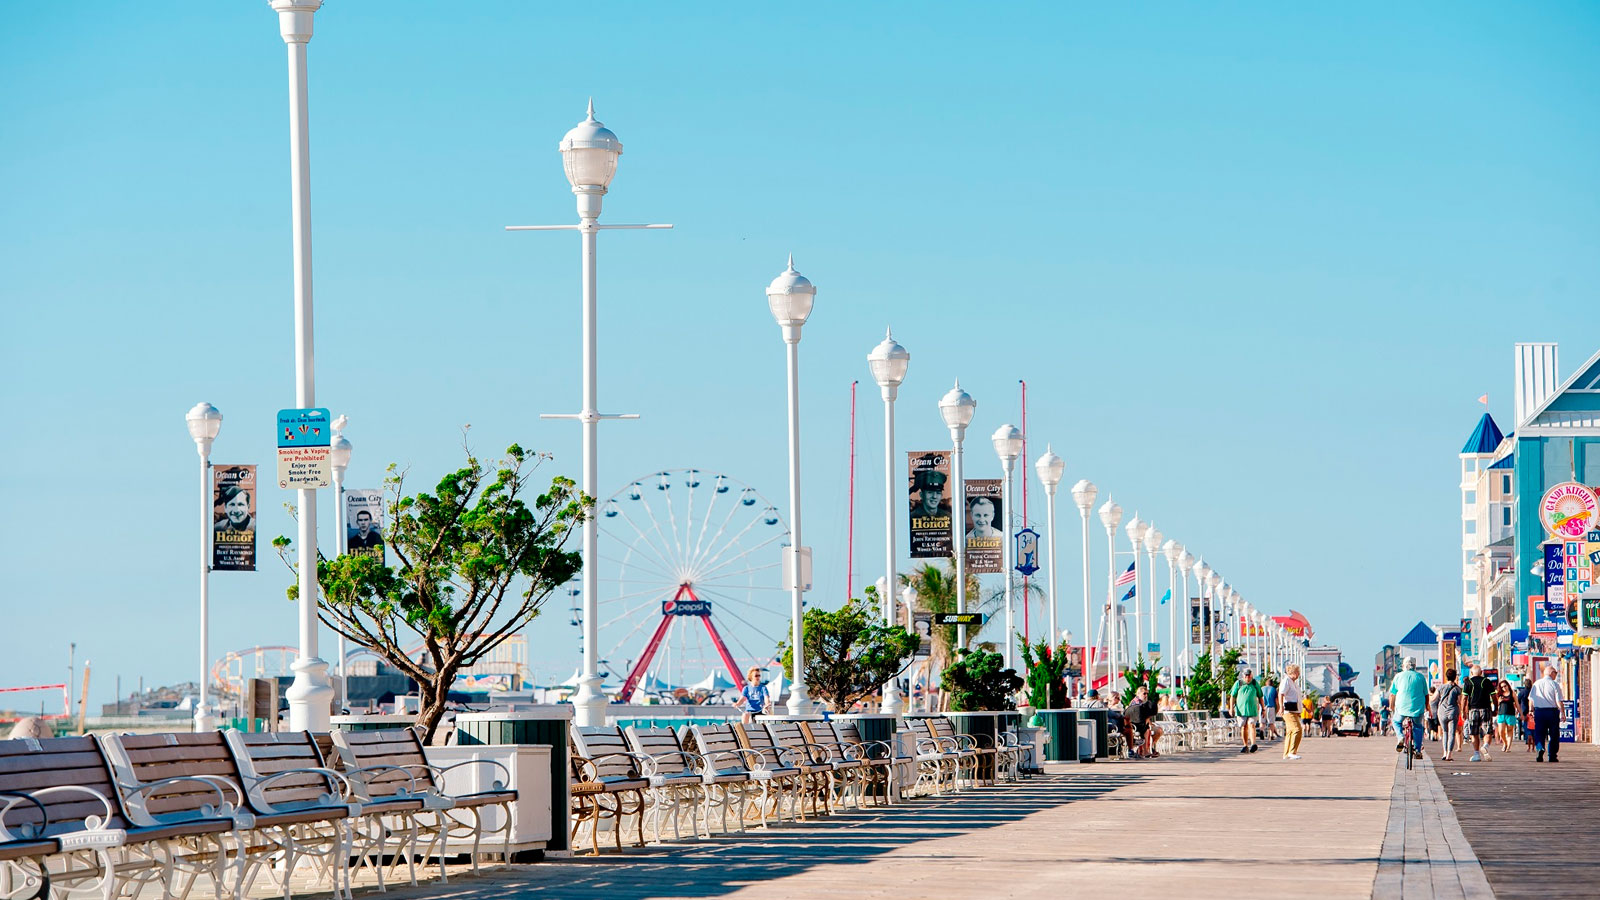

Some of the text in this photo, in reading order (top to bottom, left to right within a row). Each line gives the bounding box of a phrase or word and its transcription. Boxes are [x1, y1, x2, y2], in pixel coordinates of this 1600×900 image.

[909, 456, 949, 466] Ocean City
[215, 470, 254, 482] Ocean City
[966, 484, 1001, 494] Ocean City
[347, 494, 382, 504] Ocean City
[1545, 486, 1595, 511] CANDY KITCHEN
[911, 518, 951, 529] Honor
[215, 531, 254, 542] Honor
[967, 538, 1001, 548] Honor
[678, 603, 703, 612] pepsi
